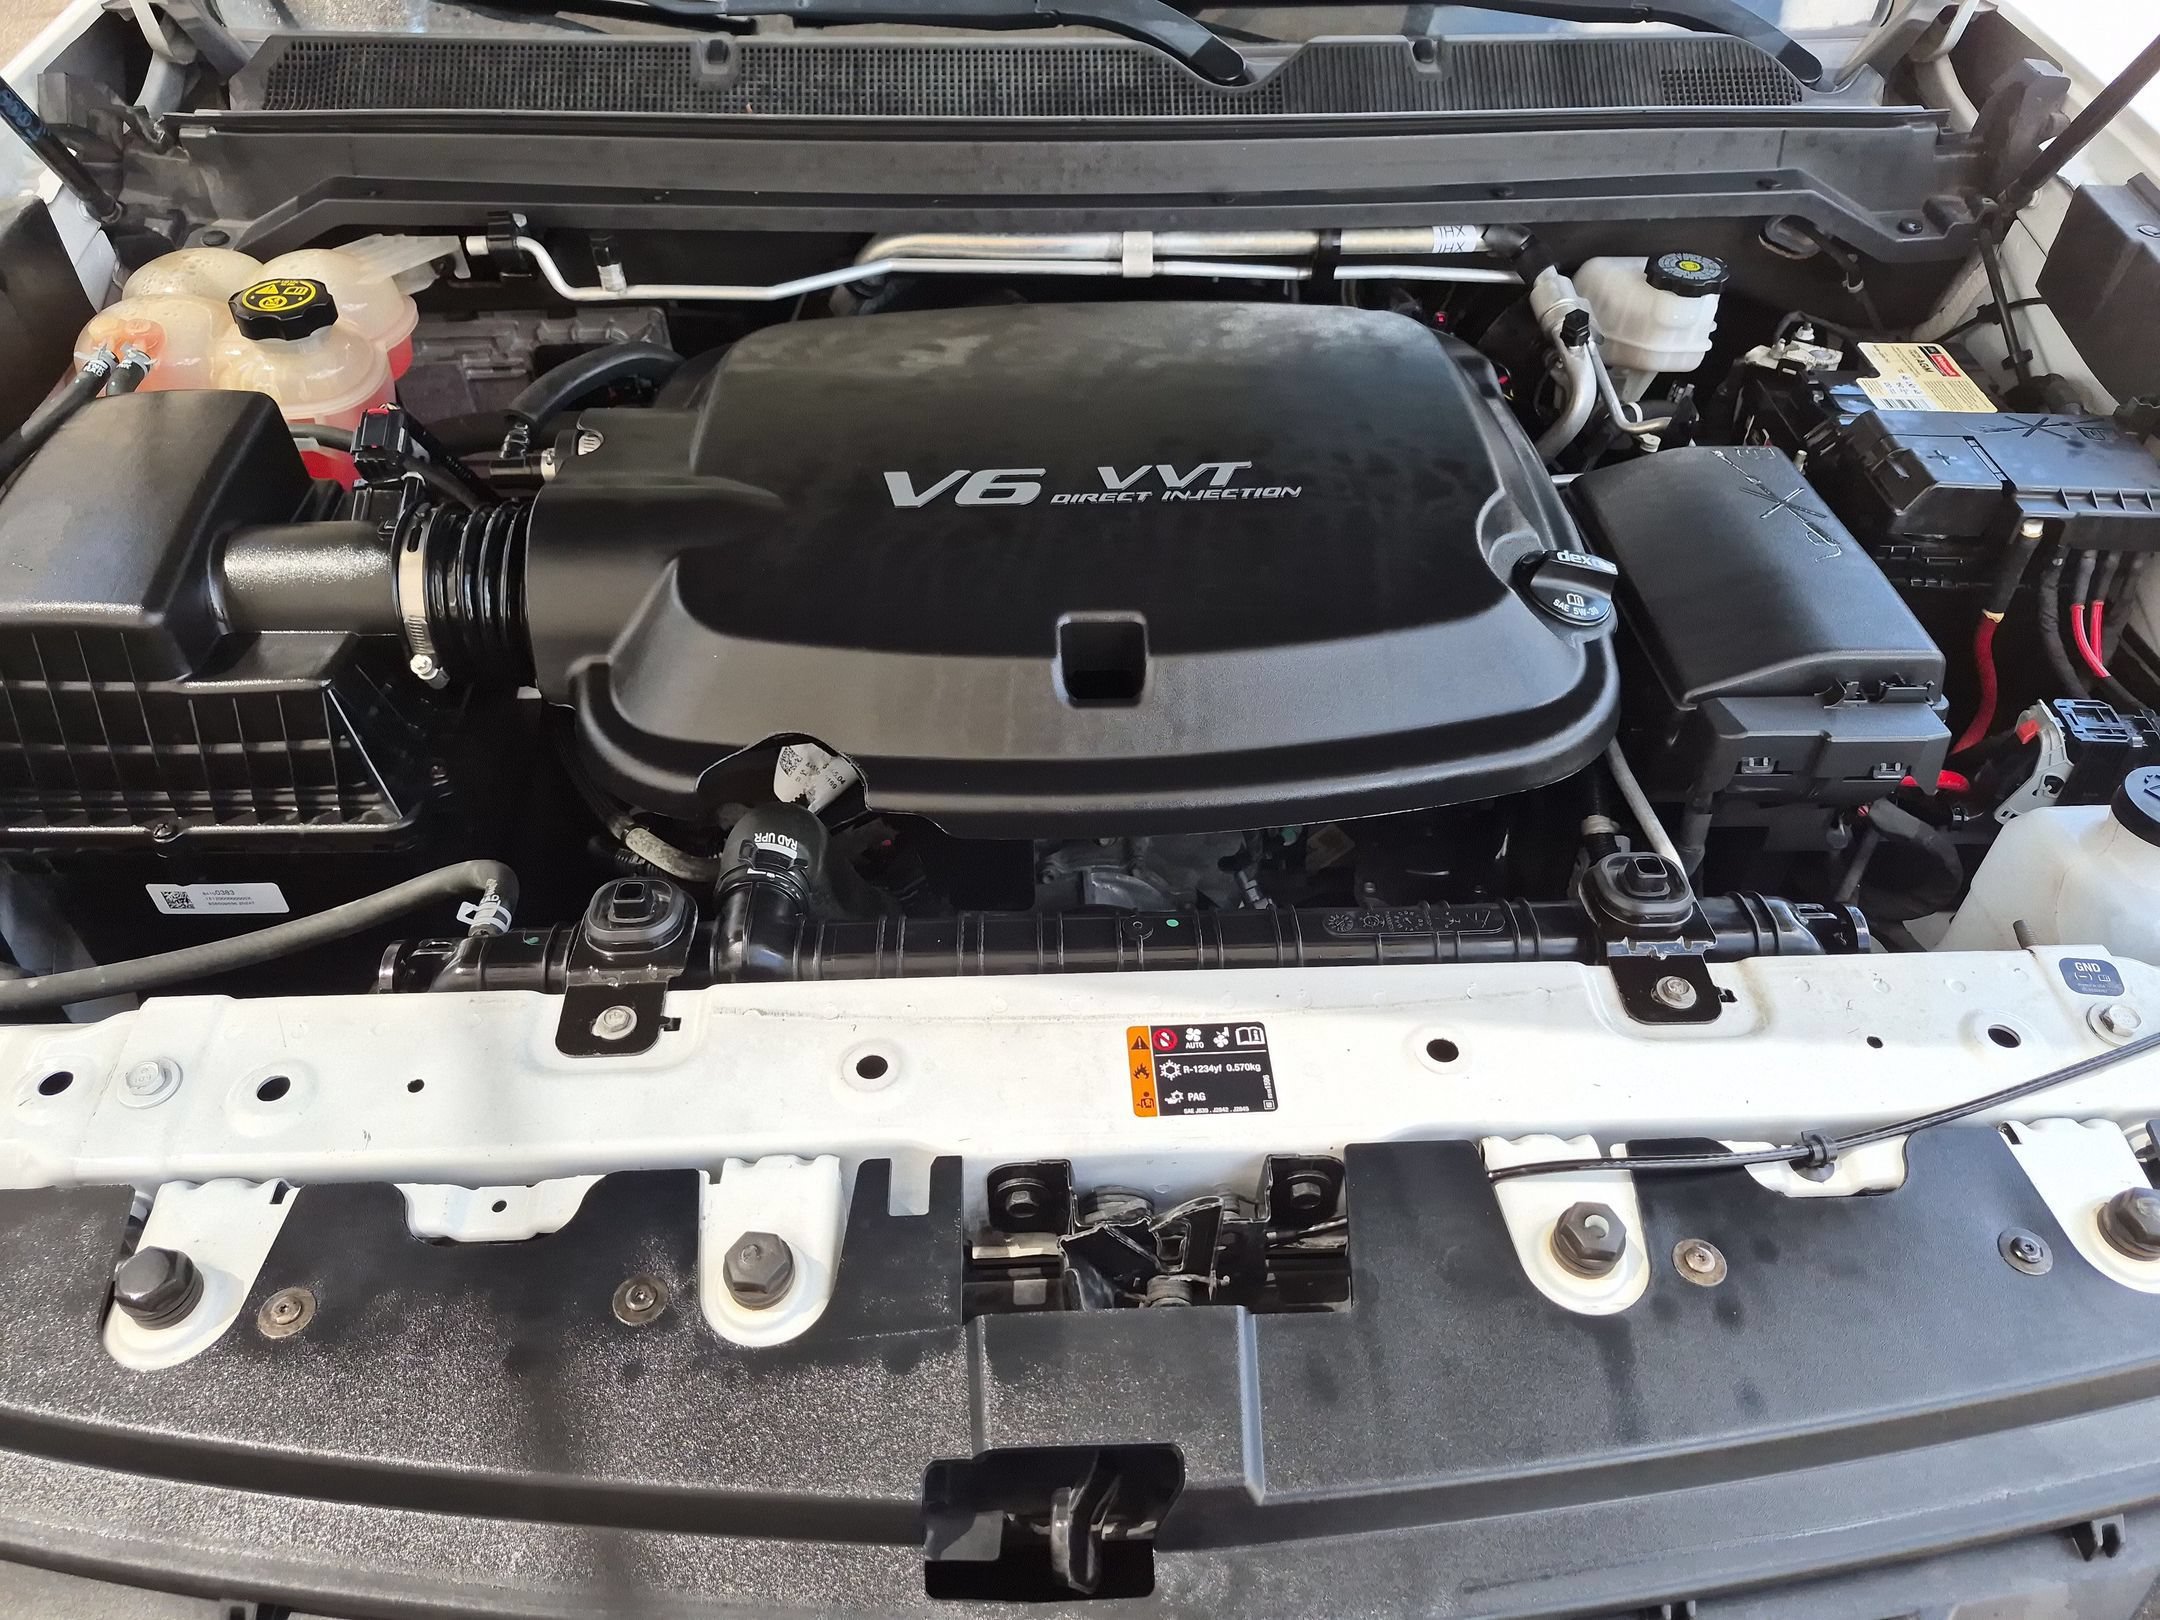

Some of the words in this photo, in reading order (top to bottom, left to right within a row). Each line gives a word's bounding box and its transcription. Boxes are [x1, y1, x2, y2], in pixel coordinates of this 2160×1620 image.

[1097, 461, 1252, 489] VVT
[883, 468, 1046, 507] V6
[1050, 491, 1152, 504] DIRECT
[1161, 486, 1302, 502] INJECTION
[1553, 599, 1569, 612] SAE
[1573, 607, 1599, 616] 5W-30
[754, 832, 776, 843] UPR
[778, 834, 798, 851] RAD
[2074, 962, 2101, 973] GND
[1185, 1041, 1204, 1049] AUTO
[1183, 1064, 1222, 1074] R-1234yf
[1226, 1063, 1262, 1072] 0.570kg
[1187, 1092, 1206, 1101] PAG
